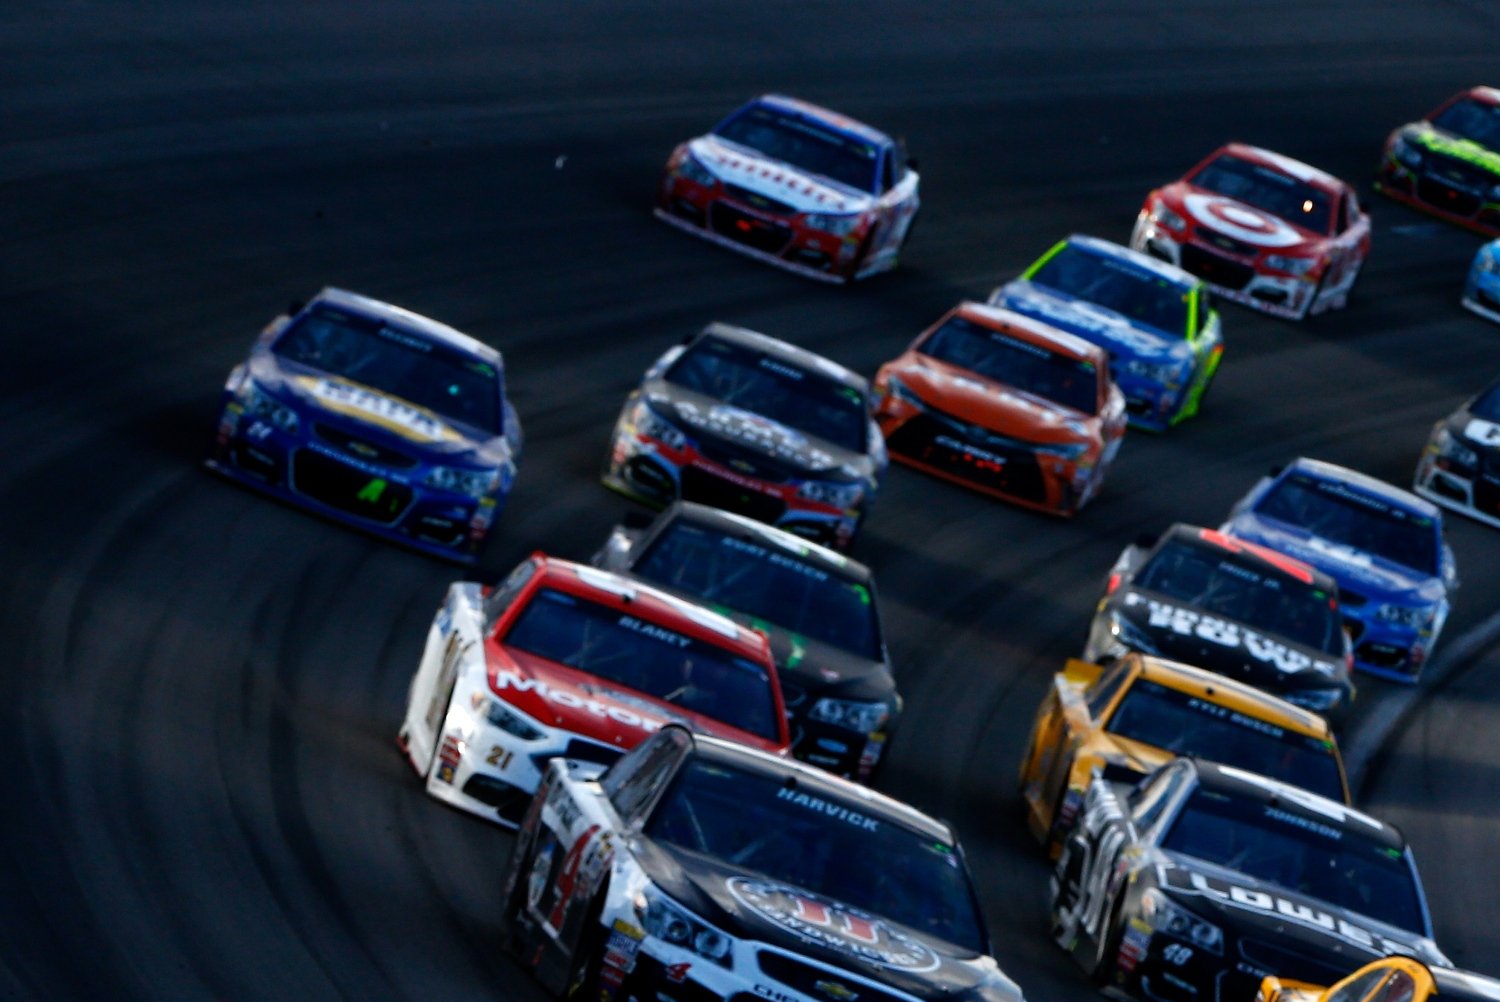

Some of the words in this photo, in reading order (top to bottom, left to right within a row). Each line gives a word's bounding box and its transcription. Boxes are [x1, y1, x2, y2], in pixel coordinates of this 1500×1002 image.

[617, 616, 693, 649] BLANEY
[1229, 713, 1285, 738] BUSCH
[486, 745, 513, 768] 21
[776, 786, 880, 833] HARVICK
[1264, 807, 1343, 840] JOHNSON
[1162, 943, 1194, 967] 48
[666, 963, 692, 984] 4
